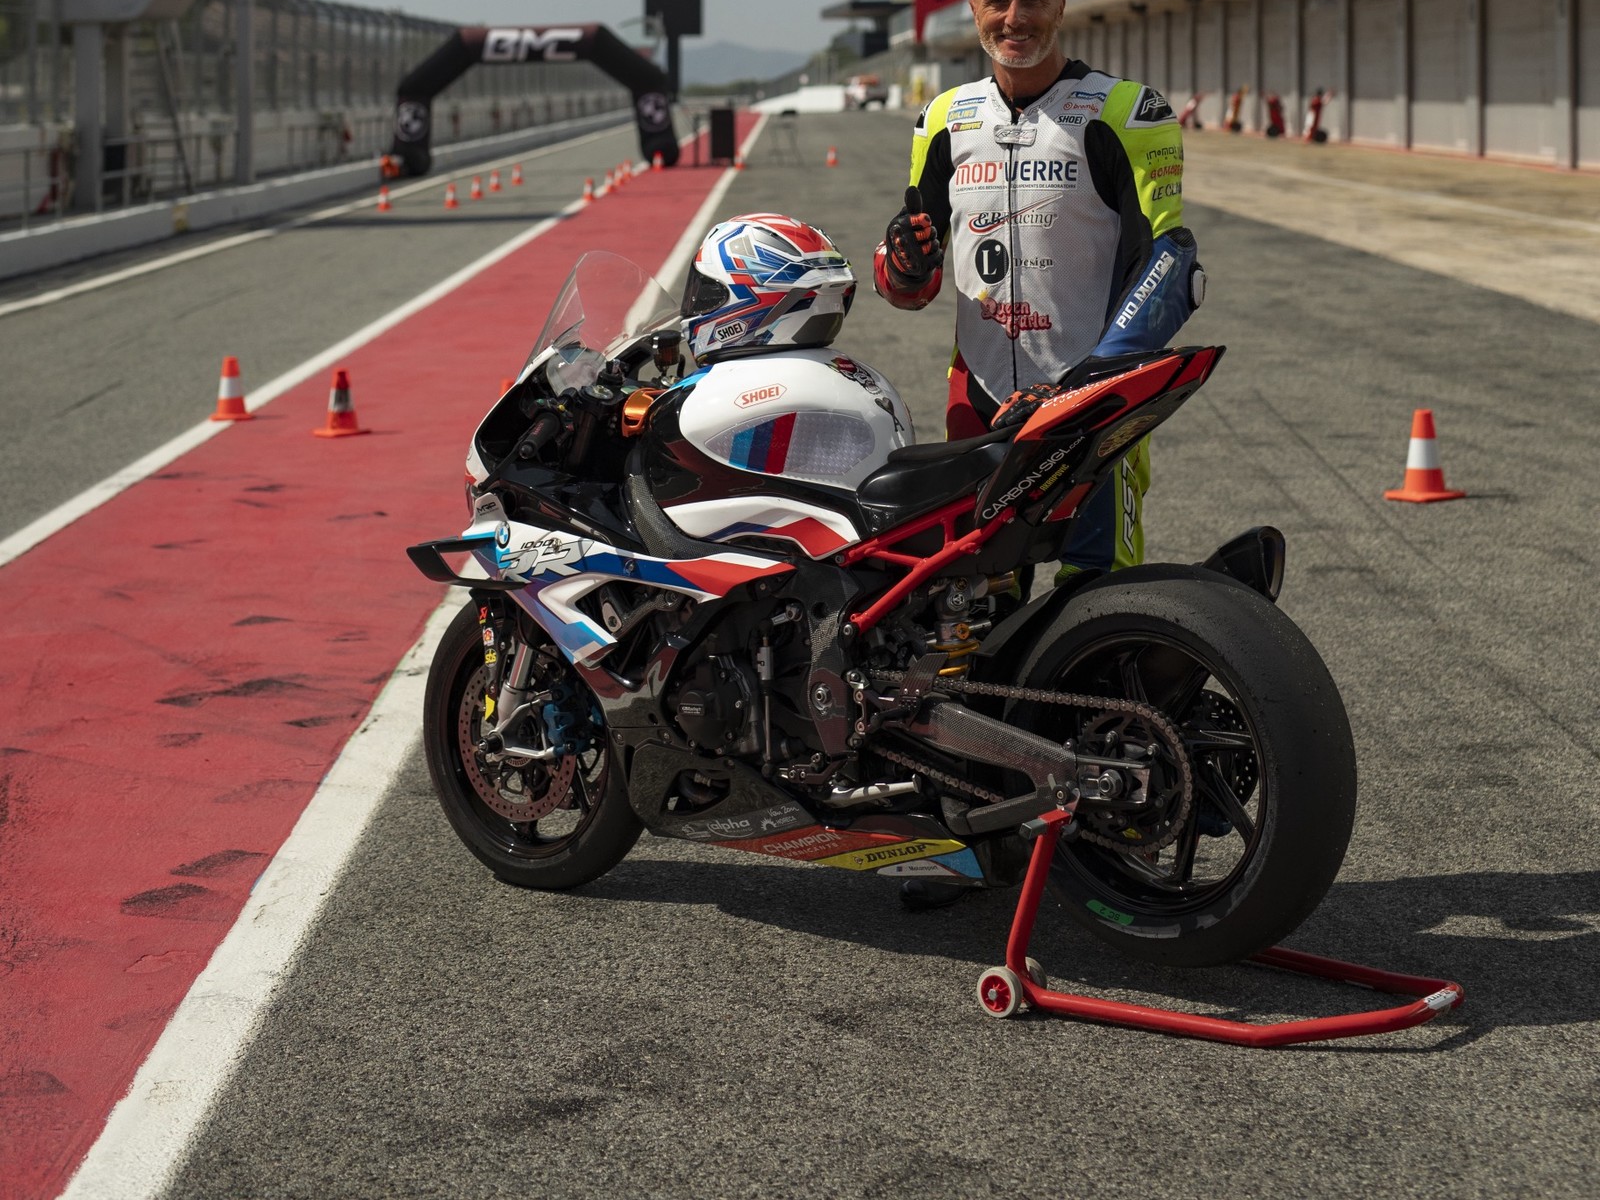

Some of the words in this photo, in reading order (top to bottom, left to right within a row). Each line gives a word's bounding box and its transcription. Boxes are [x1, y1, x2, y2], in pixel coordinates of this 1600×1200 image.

[482, 27, 584, 62] BMC
[1058, 114, 1084, 125] SHOEI
[1014, 257, 1054, 269] Design
[980, 296, 1031, 325] Queen
[1115, 301, 1139, 330] PIO
[716, 321, 744, 341] SHOEI
[740, 386, 780, 406] SHOEI
[710, 818, 751, 833] alpha
[762, 832, 842, 854] CHAMPION
[866, 842, 927, 863] DUNLOP
